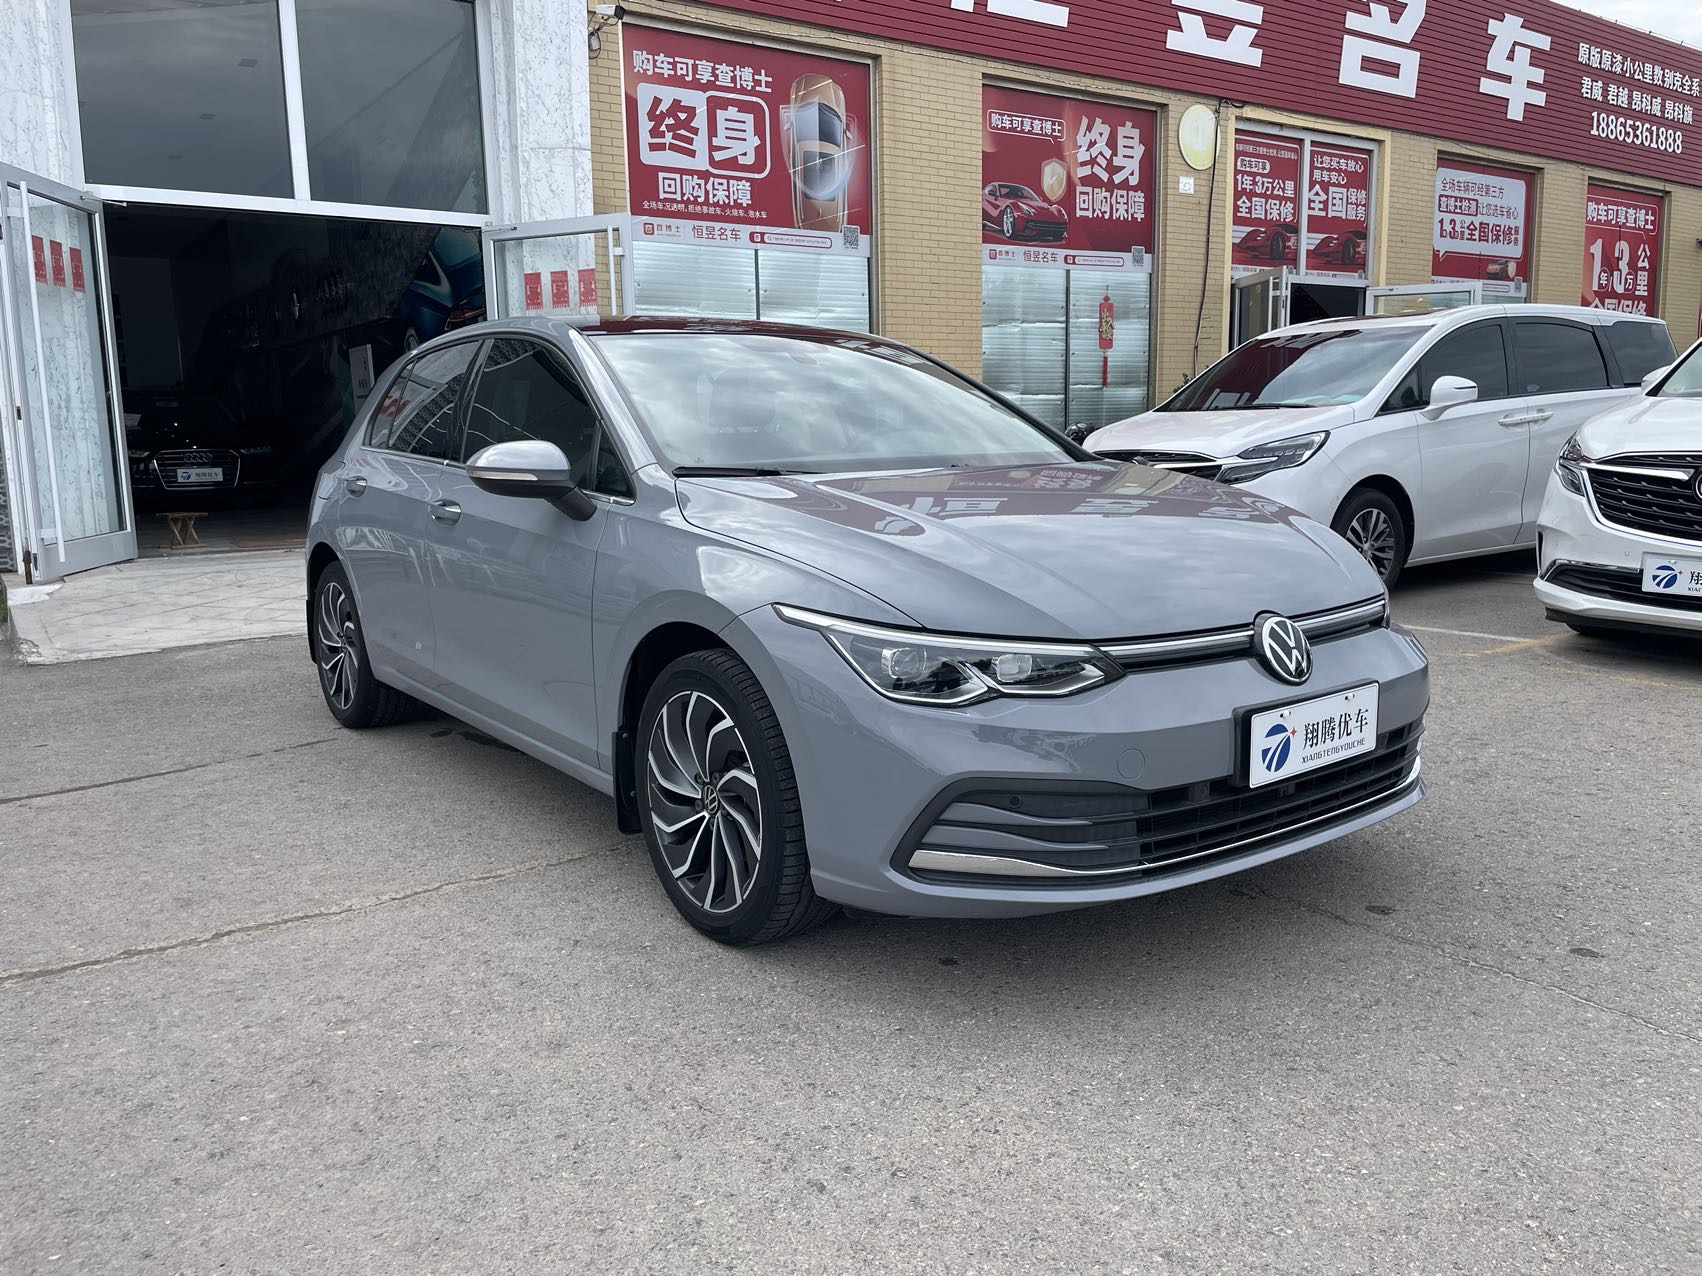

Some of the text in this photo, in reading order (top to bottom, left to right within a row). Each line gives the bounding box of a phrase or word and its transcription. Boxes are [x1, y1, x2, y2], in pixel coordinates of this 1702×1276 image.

[632, 50, 773, 93] 购车可享查博士
[1581, 76, 1603, 102] 君威
[1607, 84, 1629, 108] 君越
[1632, 91, 1662, 117] 昂科威
[646, 95, 762, 165] 终身
[991, 114, 1062, 136] 购车可享查博士
[1590, 111, 1683, 154] 18865361888
[1076, 115, 1145, 186] 终身
[1313, 155, 1364, 173] 让您买车放心
[658, 172, 752, 207] 回购保障
[1313, 170, 1347, 185] 用车安心
[1075, 186, 1145, 222] 回购保障
[1237, 195, 1294, 222] 全国保修
[1587, 201, 1655, 229] 购车可享查博士
[692, 224, 742, 242] 恒昱名车
[1023, 250, 1058, 263] 恒昱名车
[1303, 708, 1369, 750] 翔腾优车
[1301, 738, 1366, 764] XIANGTENGYOUCHE
